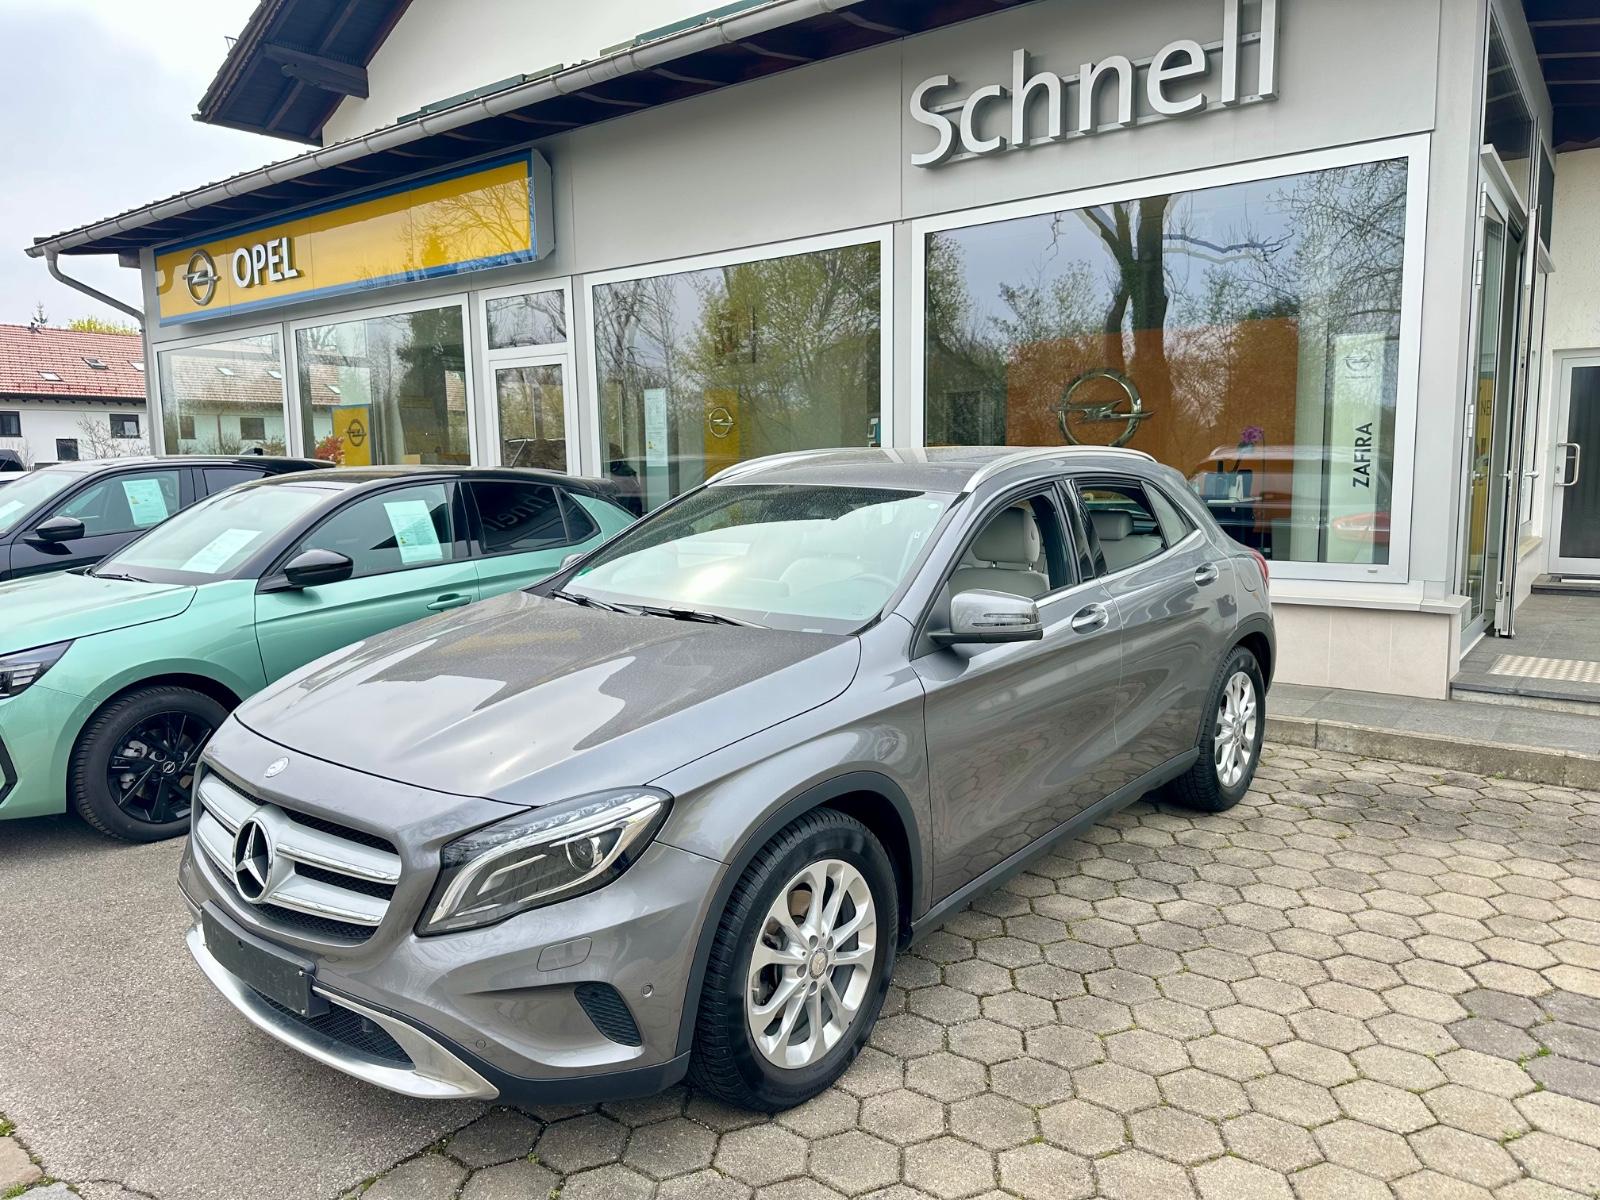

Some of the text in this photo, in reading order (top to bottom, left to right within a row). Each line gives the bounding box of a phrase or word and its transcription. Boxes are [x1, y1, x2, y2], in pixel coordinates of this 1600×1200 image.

[909, 0, 1279, 168] Schnell
[232, 237, 298, 289] OPEL
[1352, 422, 1373, 489] ZAFIRA
